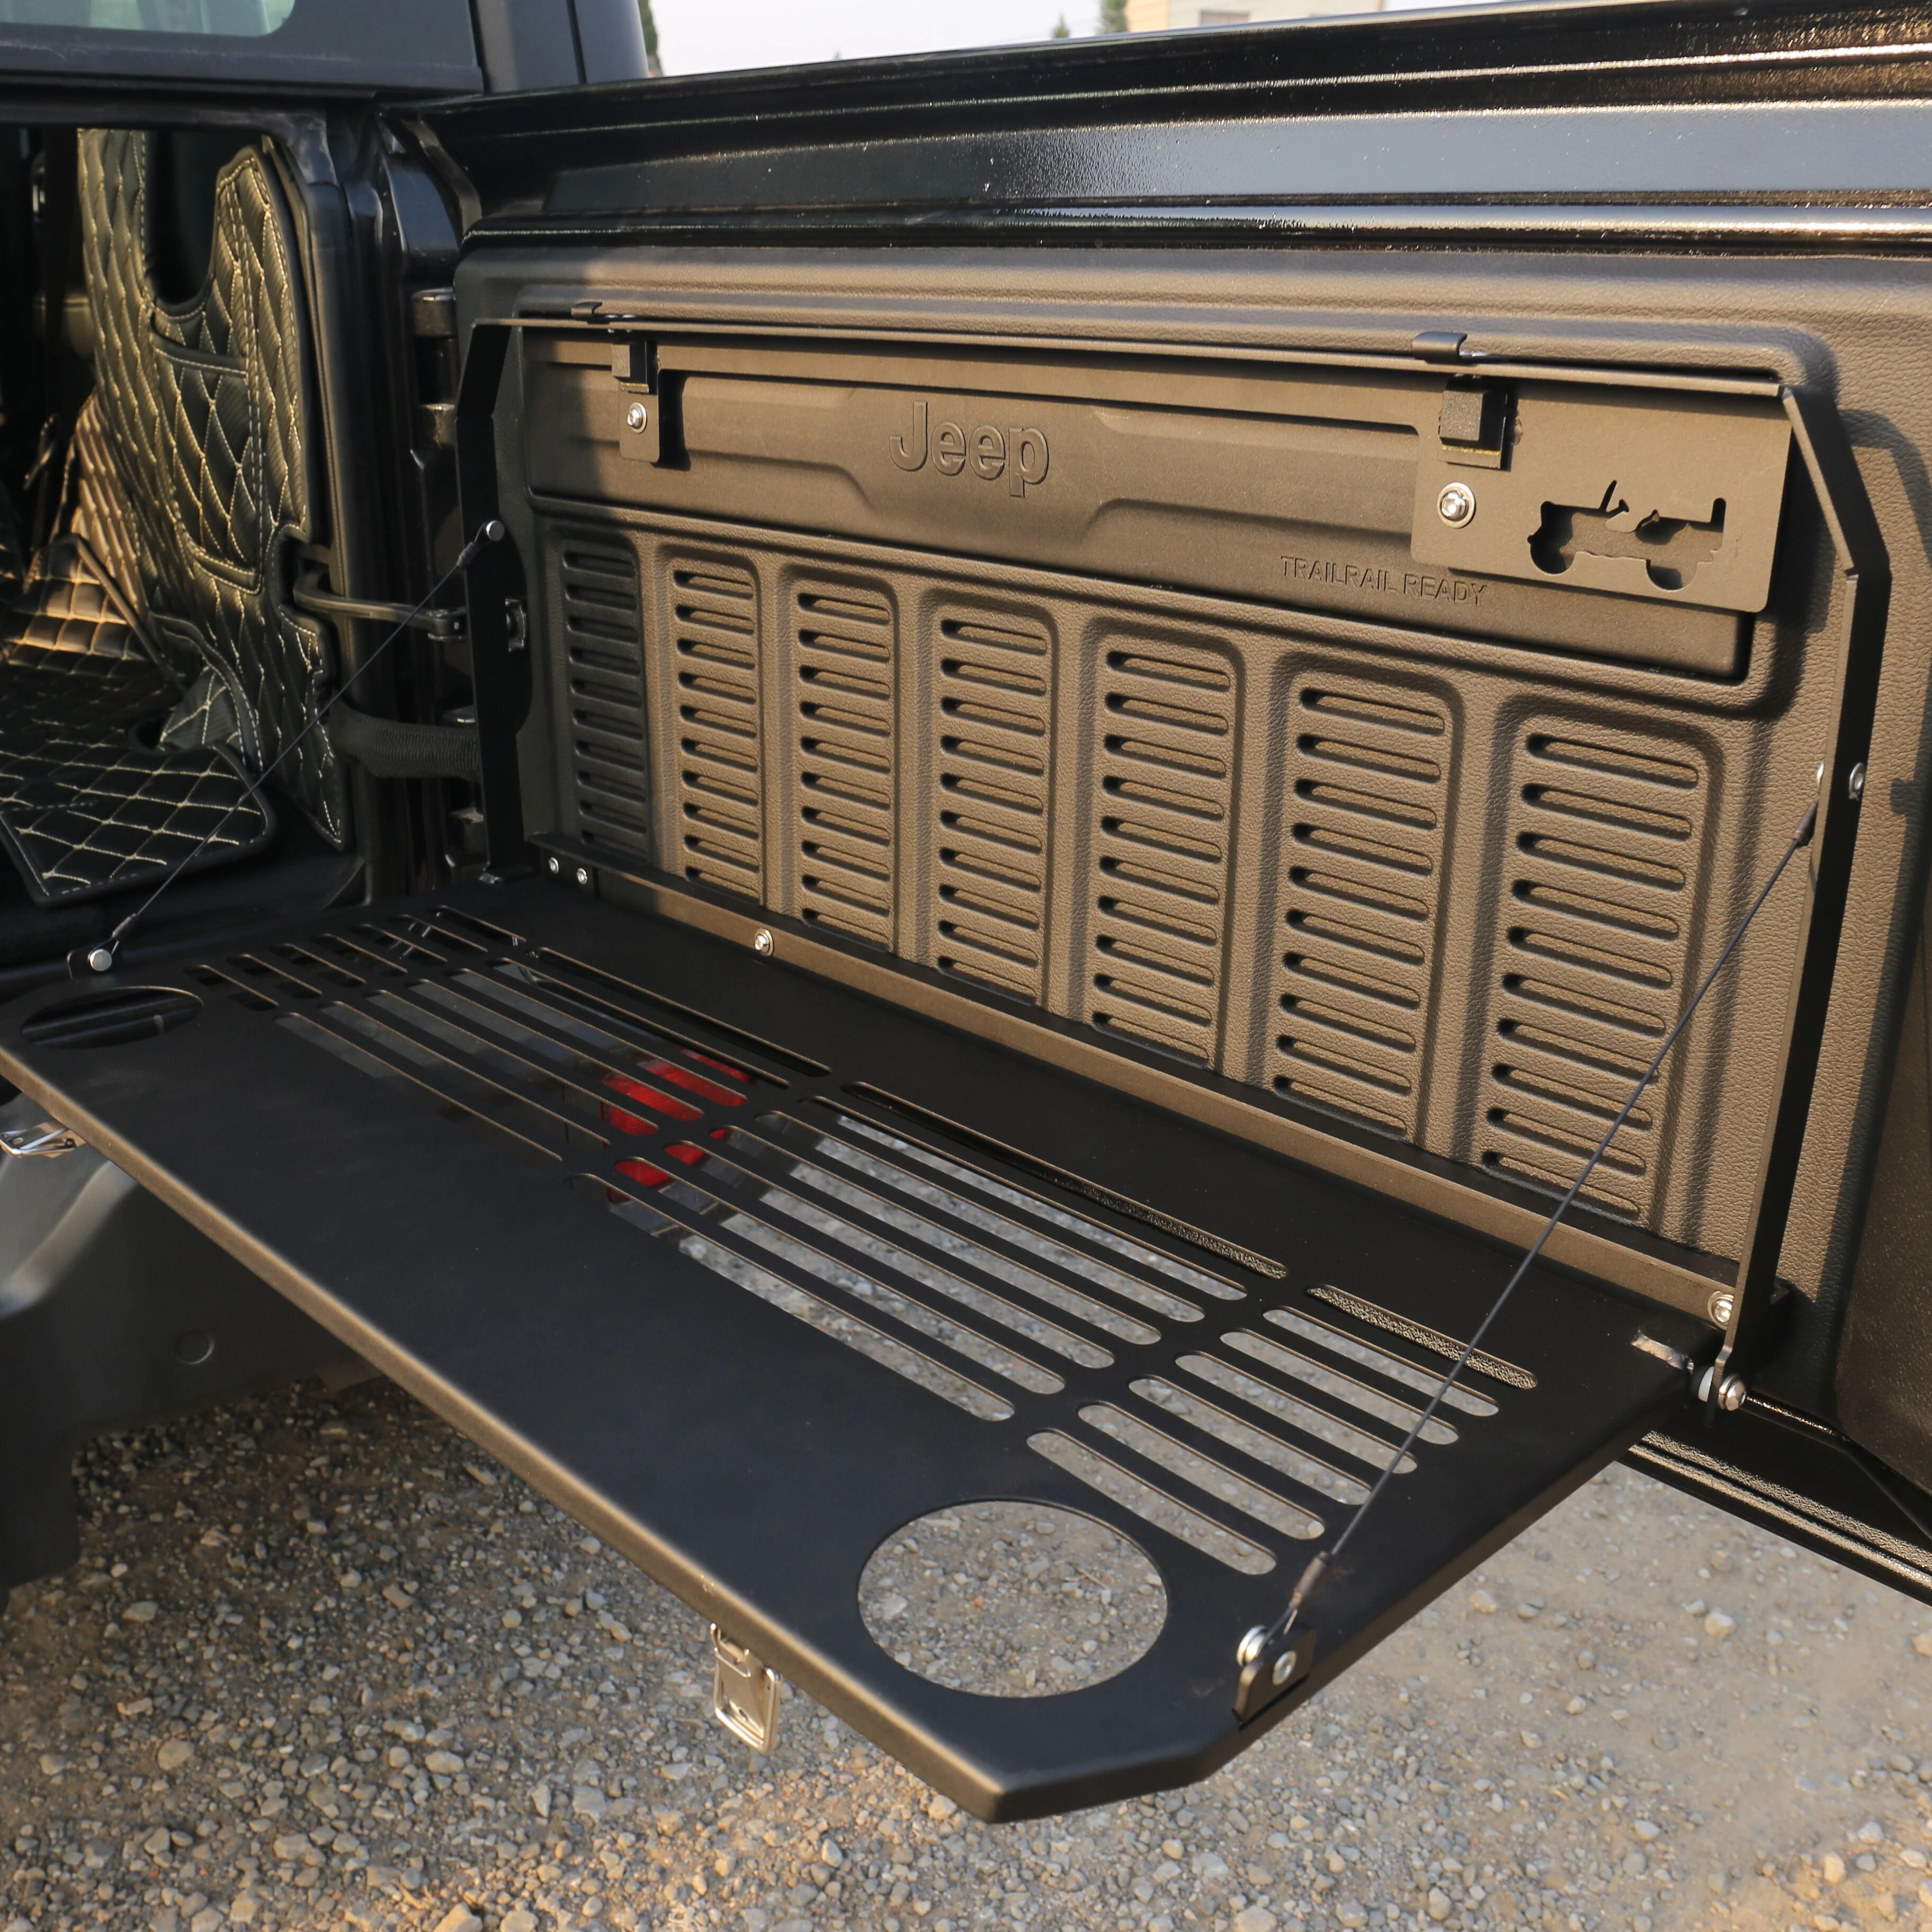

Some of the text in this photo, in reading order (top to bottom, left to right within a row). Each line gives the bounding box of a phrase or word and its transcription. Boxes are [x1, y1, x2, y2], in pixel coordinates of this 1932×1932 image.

[889, 401, 1050, 498] Jeep
[1281, 556, 1487, 605] TRAILRAIL READY
